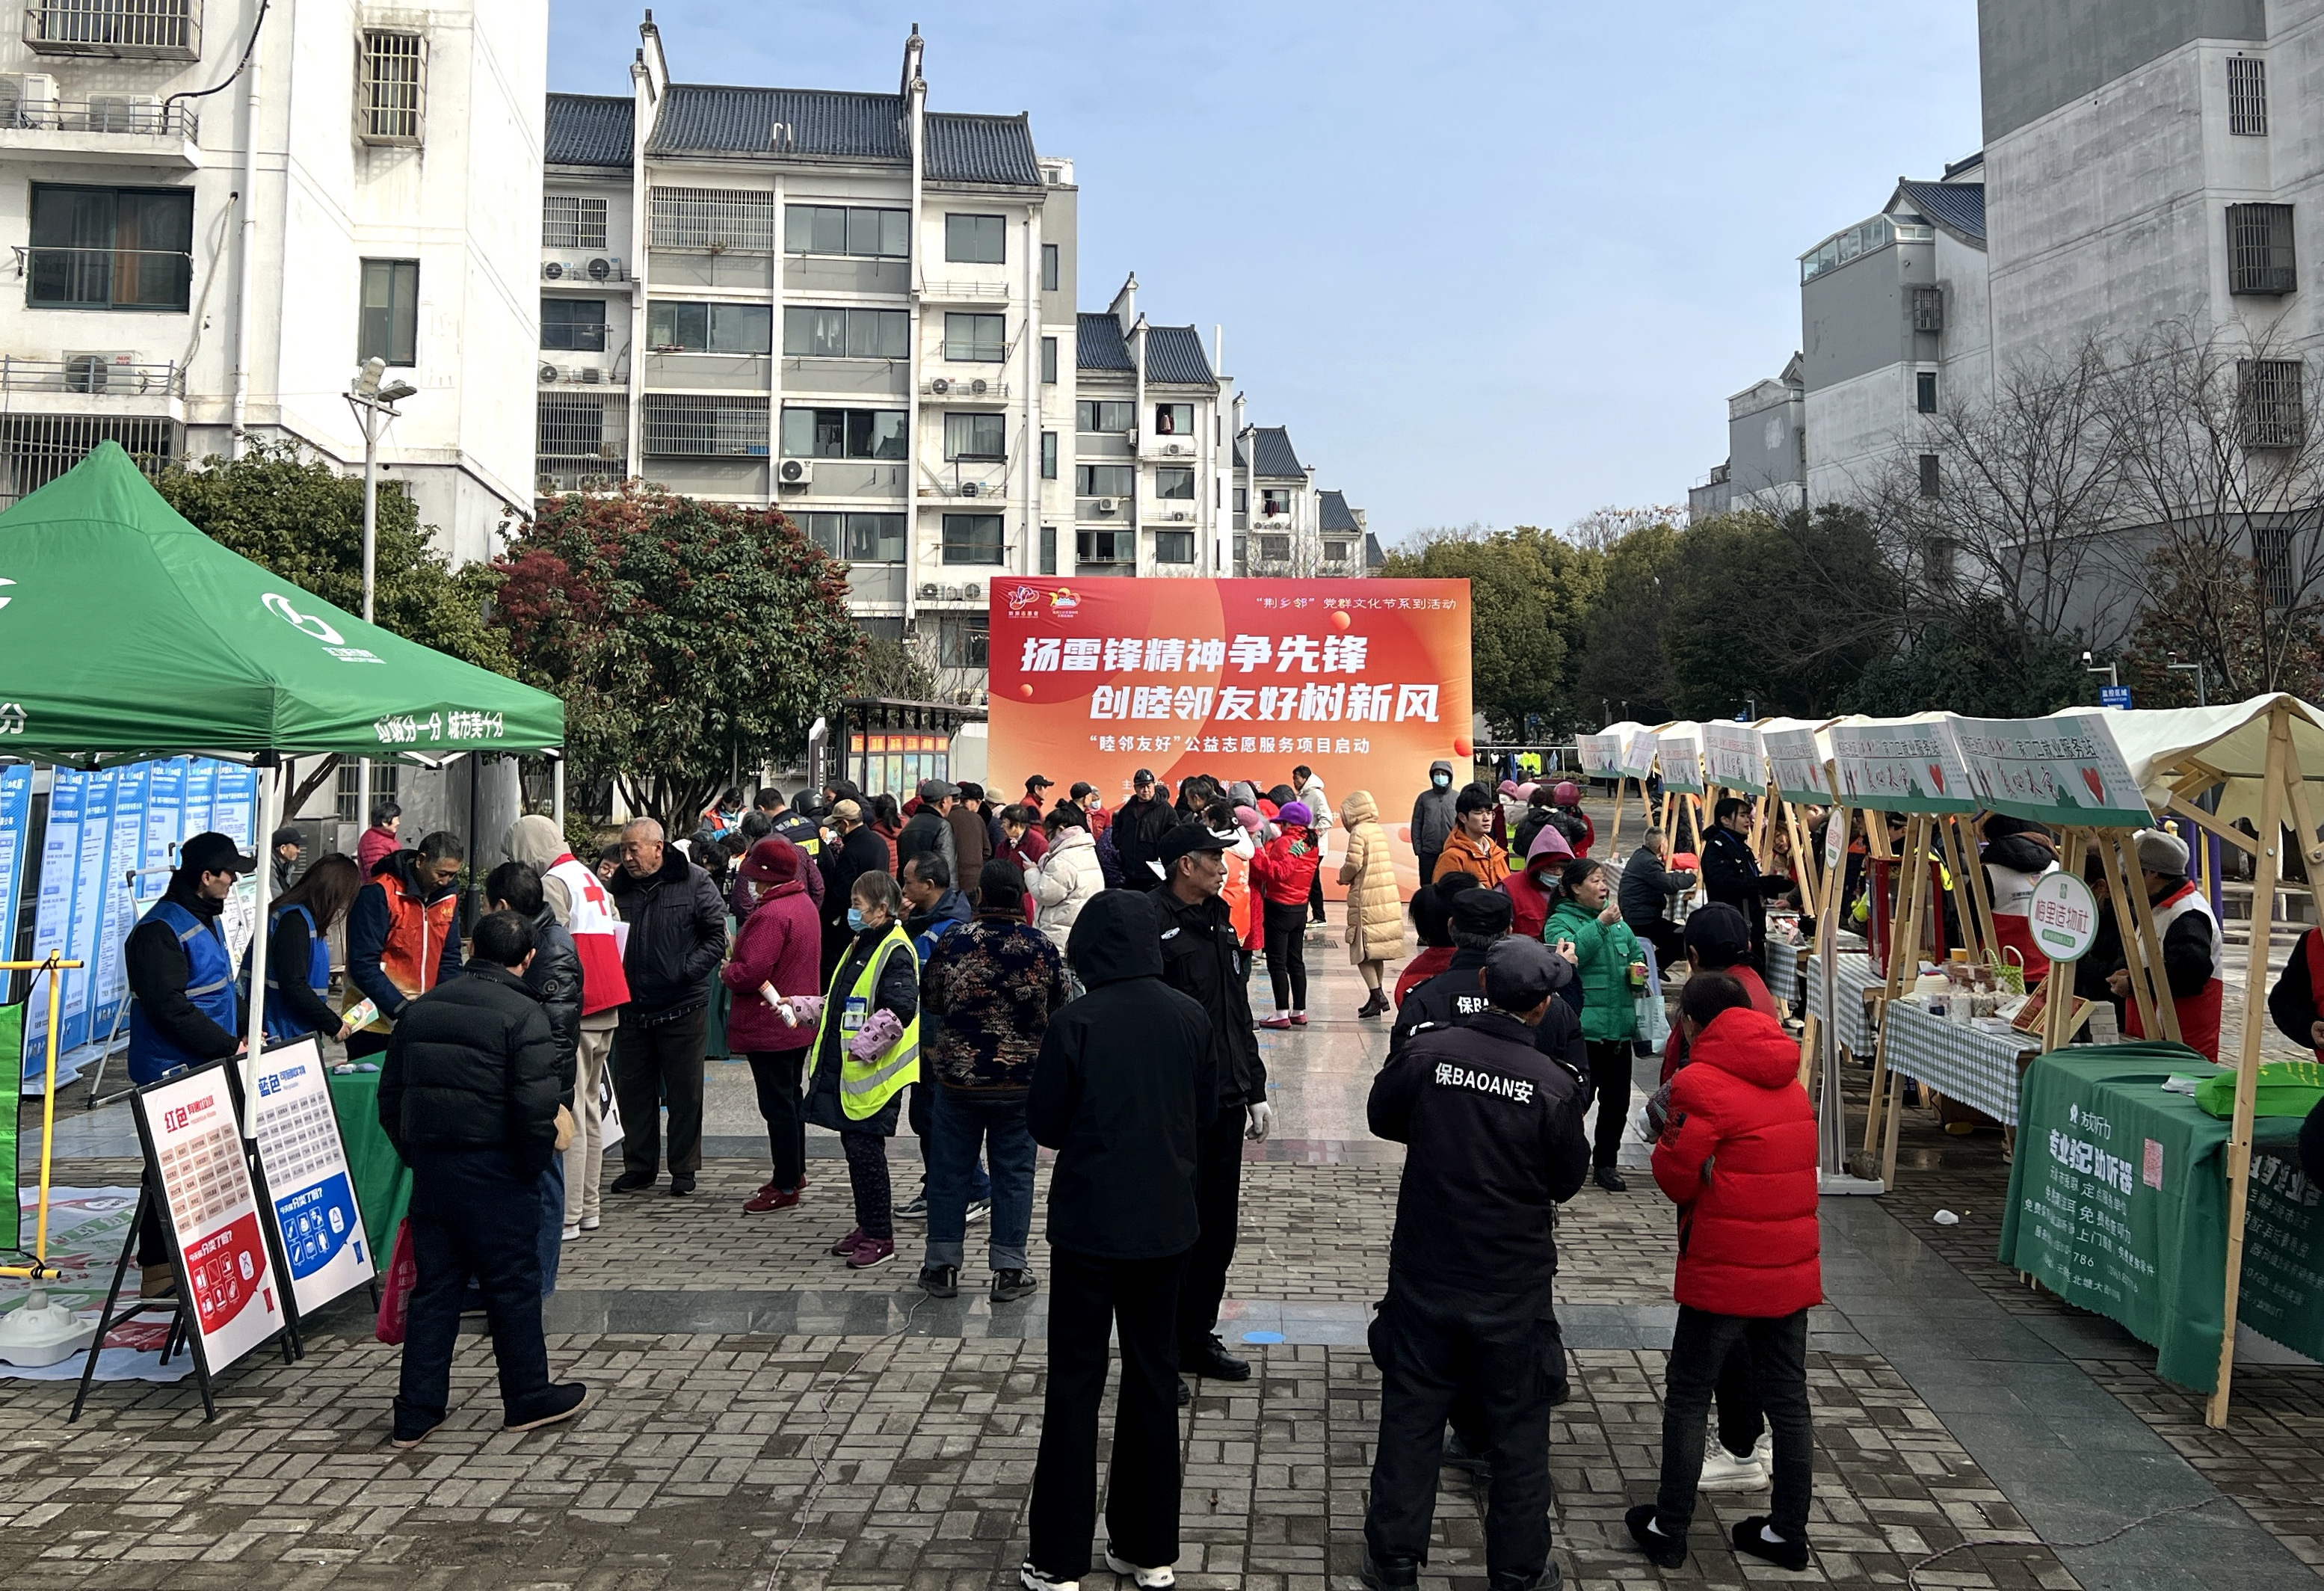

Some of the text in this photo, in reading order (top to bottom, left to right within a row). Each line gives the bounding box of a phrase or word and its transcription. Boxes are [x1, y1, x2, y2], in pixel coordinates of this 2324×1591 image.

[1020, 633, 1369, 674] 扬雷锋精神争先锋
[1089, 682, 1440, 724] 创睦邻友好树新风
[1435, 1062, 1534, 1104] 保BAOAN安
[164, 1107, 189, 1133] 红色
